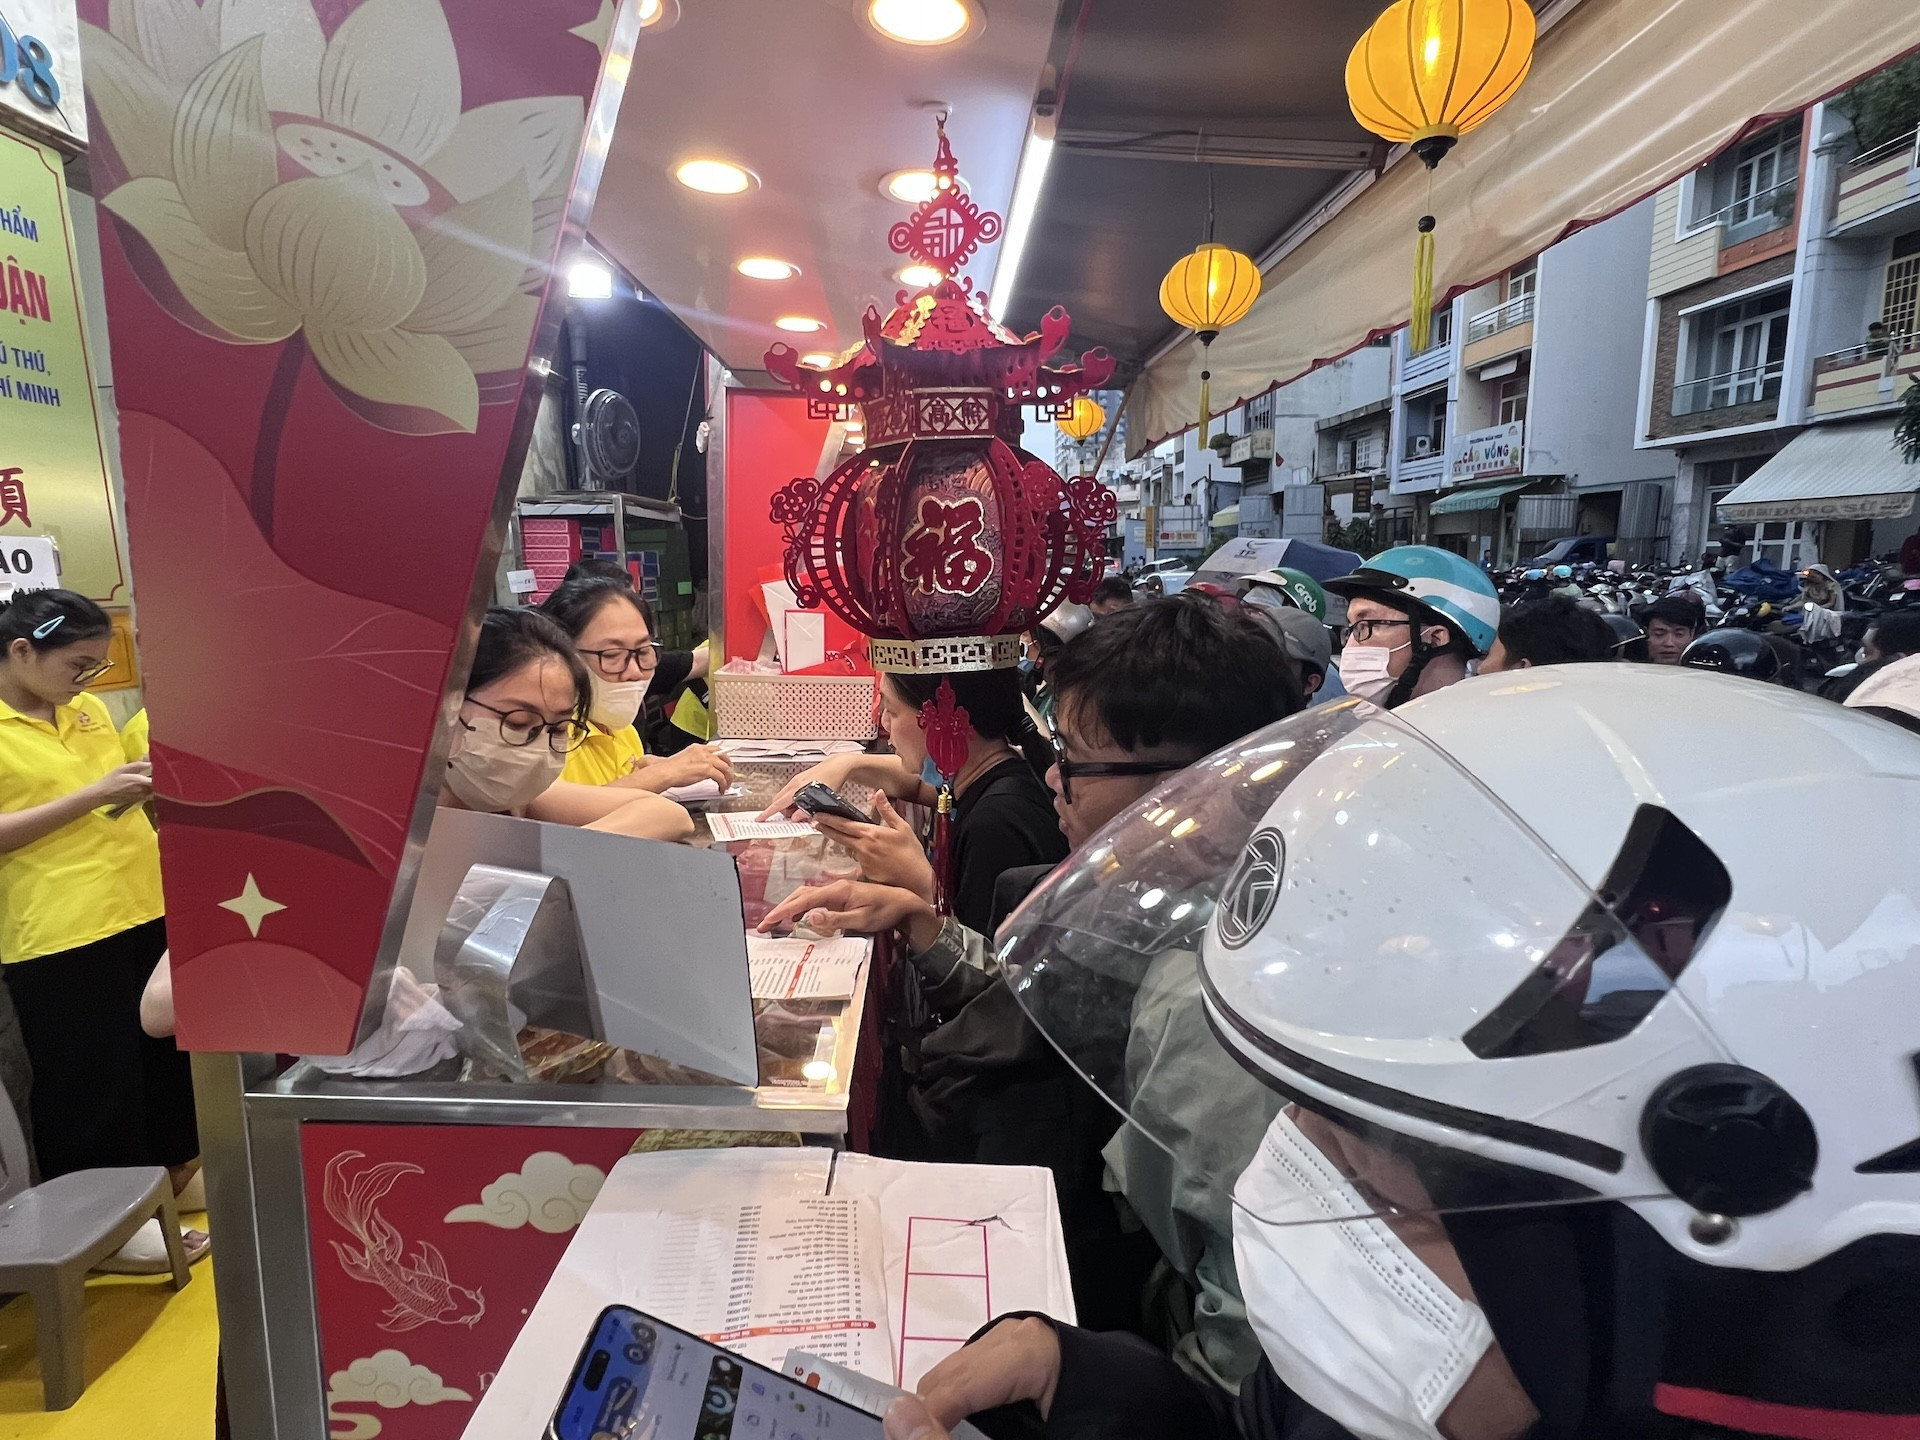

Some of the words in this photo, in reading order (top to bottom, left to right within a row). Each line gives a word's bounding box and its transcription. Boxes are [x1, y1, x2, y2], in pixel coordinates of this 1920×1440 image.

[16, 381, 61, 407] MINH
[900, 496, 994, 597] 福
[1294, 583, 1318, 613] Grab
